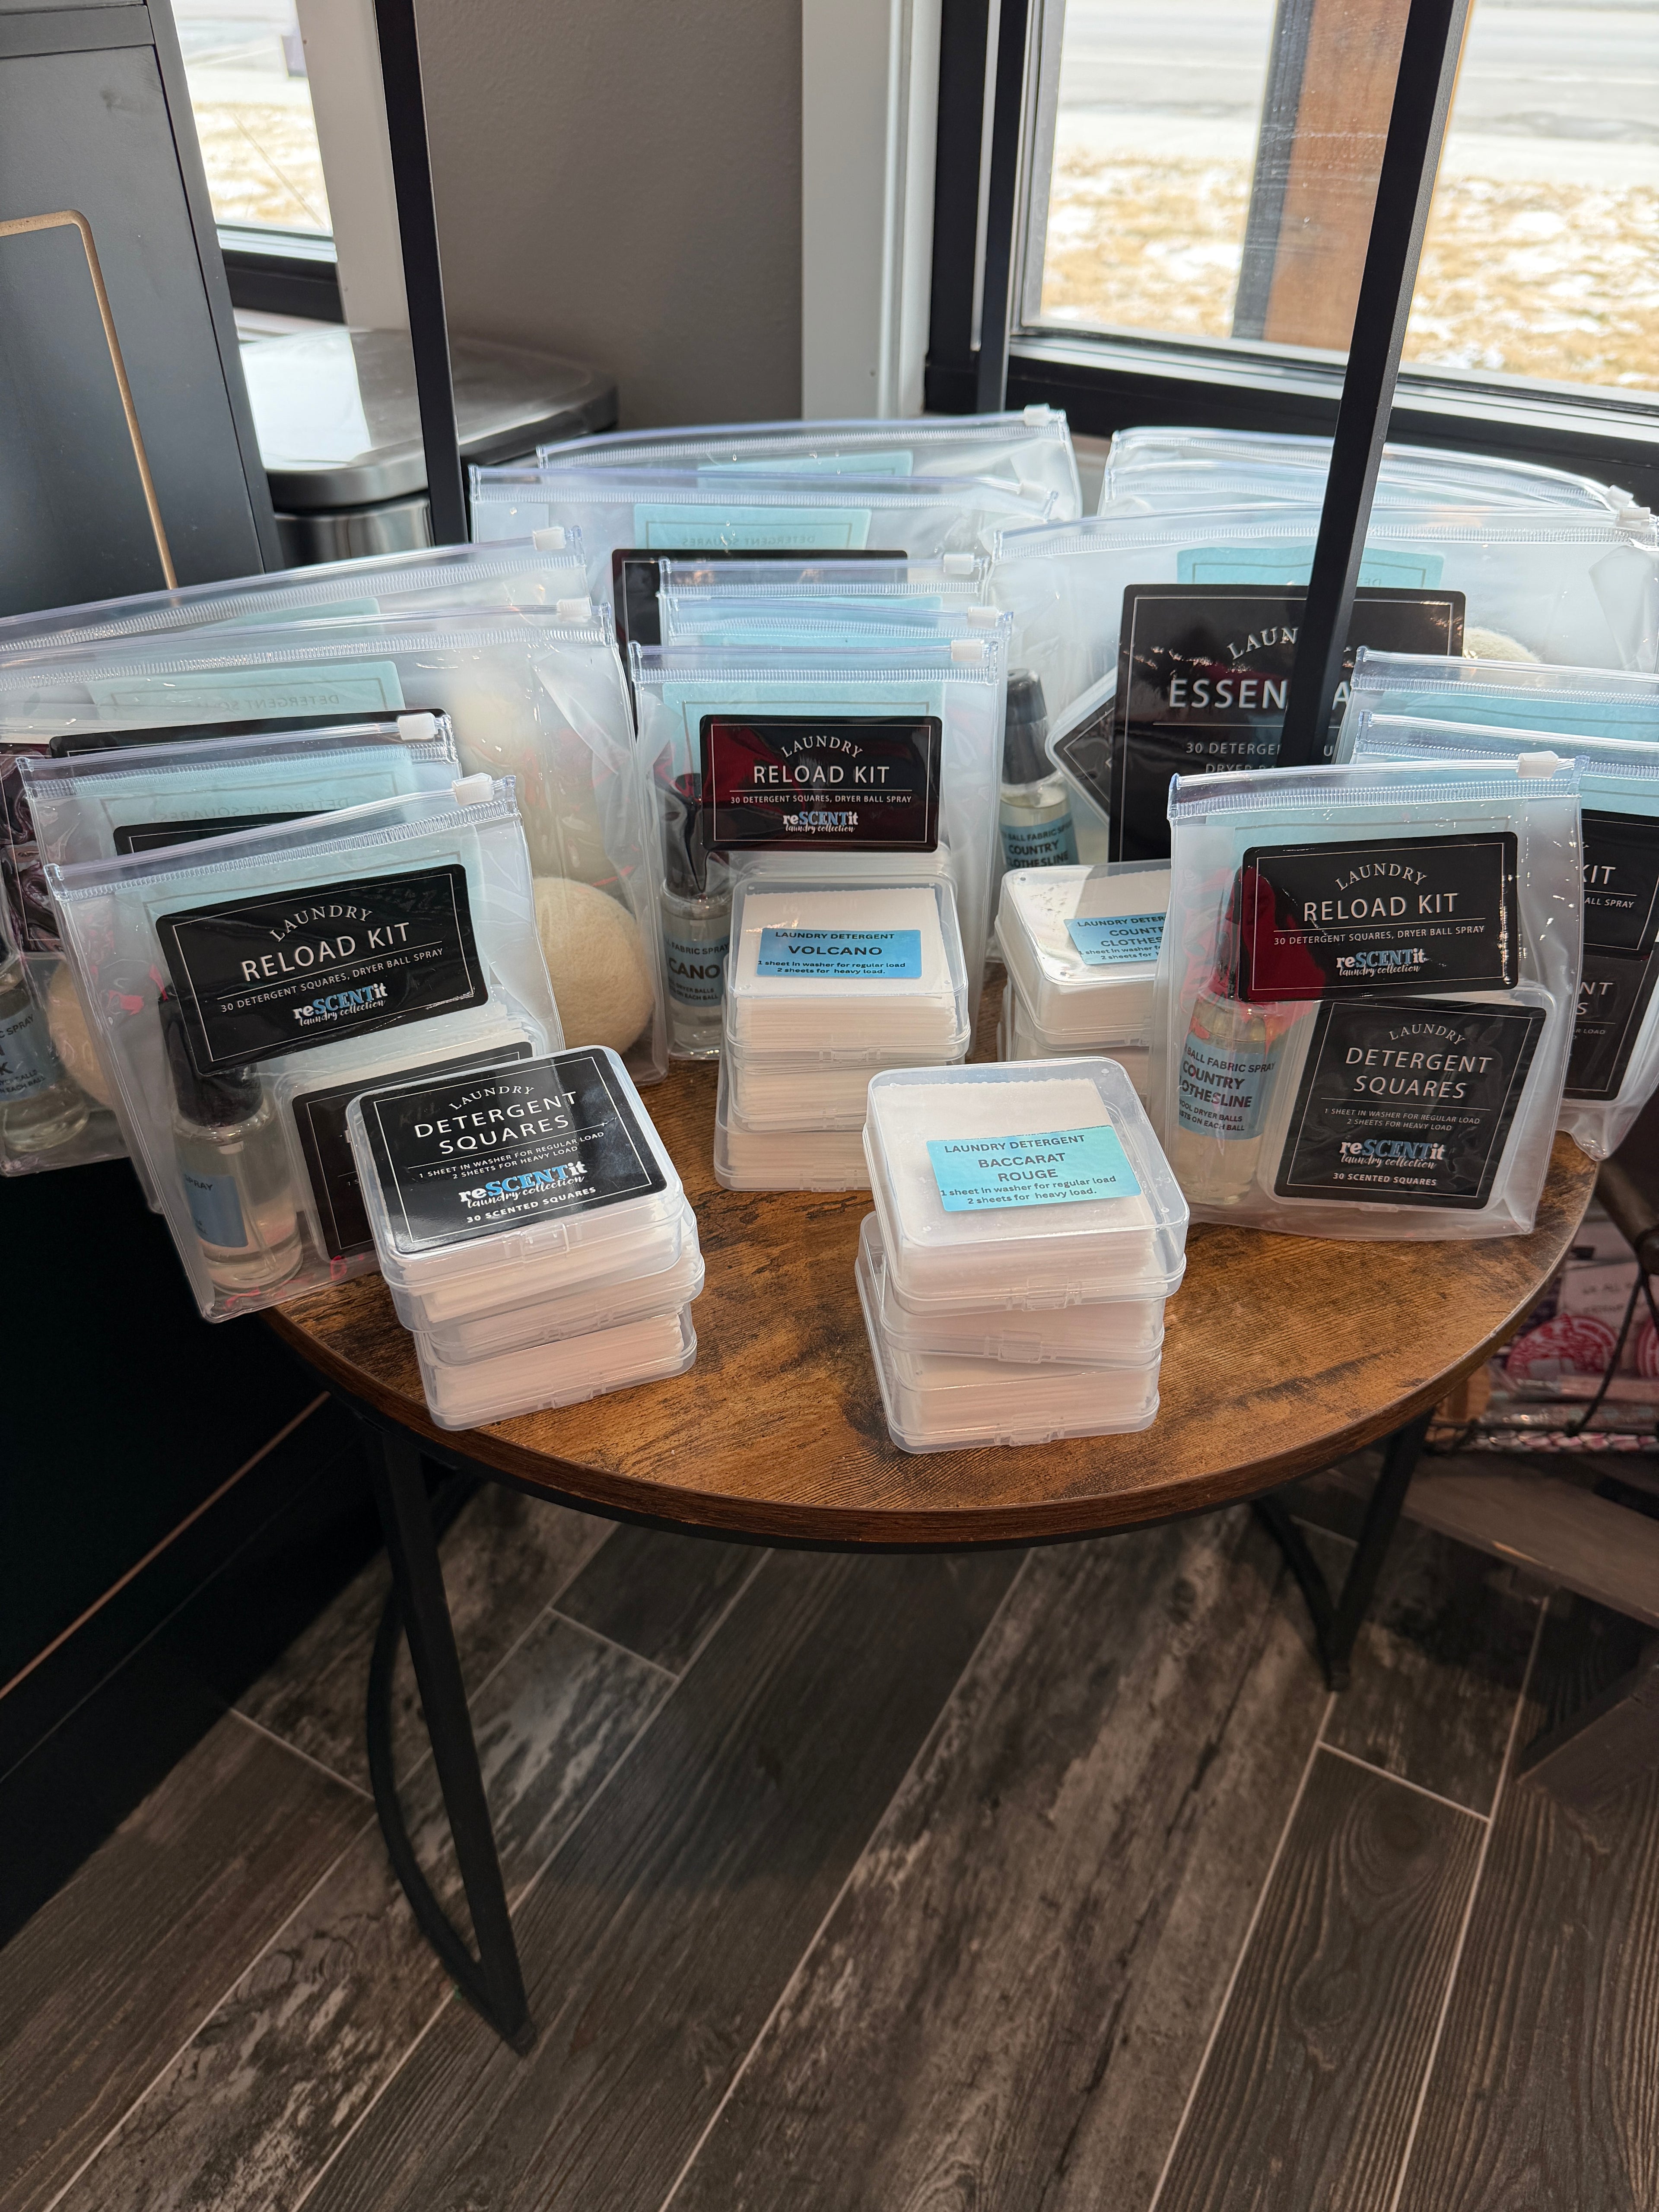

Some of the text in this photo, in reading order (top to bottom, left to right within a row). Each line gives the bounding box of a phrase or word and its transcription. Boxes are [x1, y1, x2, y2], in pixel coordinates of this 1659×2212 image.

[1227, 626, 1298, 660] LAUN
[781, 735, 863, 758] LAUNDRY
[1186, 743, 1280, 755] 30 DETERGE
[754, 765, 890, 784] RELOAD KIT
[793, 795, 833, 803] SQUARES,
[782, 810, 858, 826] reSCENTit
[785, 820, 855, 834] laundry collection
[1027, 829, 1057, 841] FABRIC
[1009, 839, 1058, 855] COUNTRY
[1335, 863, 1427, 891] LAUNDRY
[1304, 893, 1459, 922] RELOAD KIT
[1584, 897, 1634, 908] ALL SPRAY
[269, 905, 373, 942] LAUNDRY
[1100, 937, 1162, 946] CLOTHES
[1290, 934, 1345, 944] DETERGENT
[1349, 931, 1394, 941] SQUARES,
[1398, 929, 1426, 938] DRYER
[1430, 928, 1452, 936] BALL
[1456, 925, 1485, 934] SPRAY
[242, 922, 409, 982] RELOAD KIT
[702, 942, 730, 955] SPRAY
[788, 945, 883, 955] VOLCANO
[1336, 948, 1425, 968] reSCENTit
[669, 957, 721, 979] CANO
[1339, 961, 1420, 977] laundry collection
[220, 948, 443, 1012] 30 DETERGENT SQUARES, DRYER BALL SPRAY
[292, 982, 388, 1020] reSCENTit
[299, 997, 386, 1027] laundry collection
[6, 1014, 34, 1036] SPRAY
[1389, 1023, 1465, 1045] LAUNDRY
[1187, 1046, 1205, 1064] BALL
[1207, 1057, 1246, 1072] FABRIC
[1248, 1062, 1276, 1073] SPRAY
[1346, 1047, 1493, 1074] DETERGENT
[1183, 1061, 1245, 1090] COUNTRY
[1353, 1075, 1467, 1099] SQUARES
[449, 1086, 534, 1110] LAUNDRY
[414, 1091, 577, 1138] DETERGENT
[1179, 1109, 1191, 1120] ISTS
[1192, 1116, 1202, 1125] ON
[1204, 1120, 1225, 1130] EACH
[1194, 1107, 1217, 1119] DRYER
[1369, 1111, 1400, 1119] WASHER
[1421, 1114, 1456, 1123] REGULAR
[439, 1115, 569, 1154] SQUARES
[944, 1135, 1084, 1153] LAUNDRY DETERGENT
[428, 1166, 457, 1178] SHEET
[473, 1154, 512, 1167] WASHER
[515, 1149, 533, 1158] FOR
[536, 1138, 578, 1153] REGULAR
[579, 1131, 604, 1143] LOAD
[978, 1152, 1065, 1168] BACCARAT
[1339, 1139, 1446, 1160] reSCENTit
[461, 1165, 496, 1179] SHEETS
[499, 1160, 517, 1169] FOR
[520, 1153, 550, 1165] HEAVY
[553, 1146, 578, 1157] LOAD
[1341, 1152, 1437, 1170] laundry collection
[458, 1161, 588, 1202] reSCENTit
[949, 1187, 979, 1196] sheet
[994, 1184, 1032, 1192] washer
[1053, 1178, 1090, 1188] regular
[1093, 1175, 1116, 1184] load
[998, 1169, 1058, 1182] ROUGE
[1347, 1173, 1390, 1183] SCENTED
[1393, 1176, 1437, 1186] SQUARES
[467, 1174, 586, 1209] laundry collection
[976, 1195, 1012, 1204] sheets
[1035, 1190, 1066, 1199] heavy
[1069, 1187, 1096, 1196] load.
[467, 1187, 596, 1223] 30 SCENTED SQUARES
